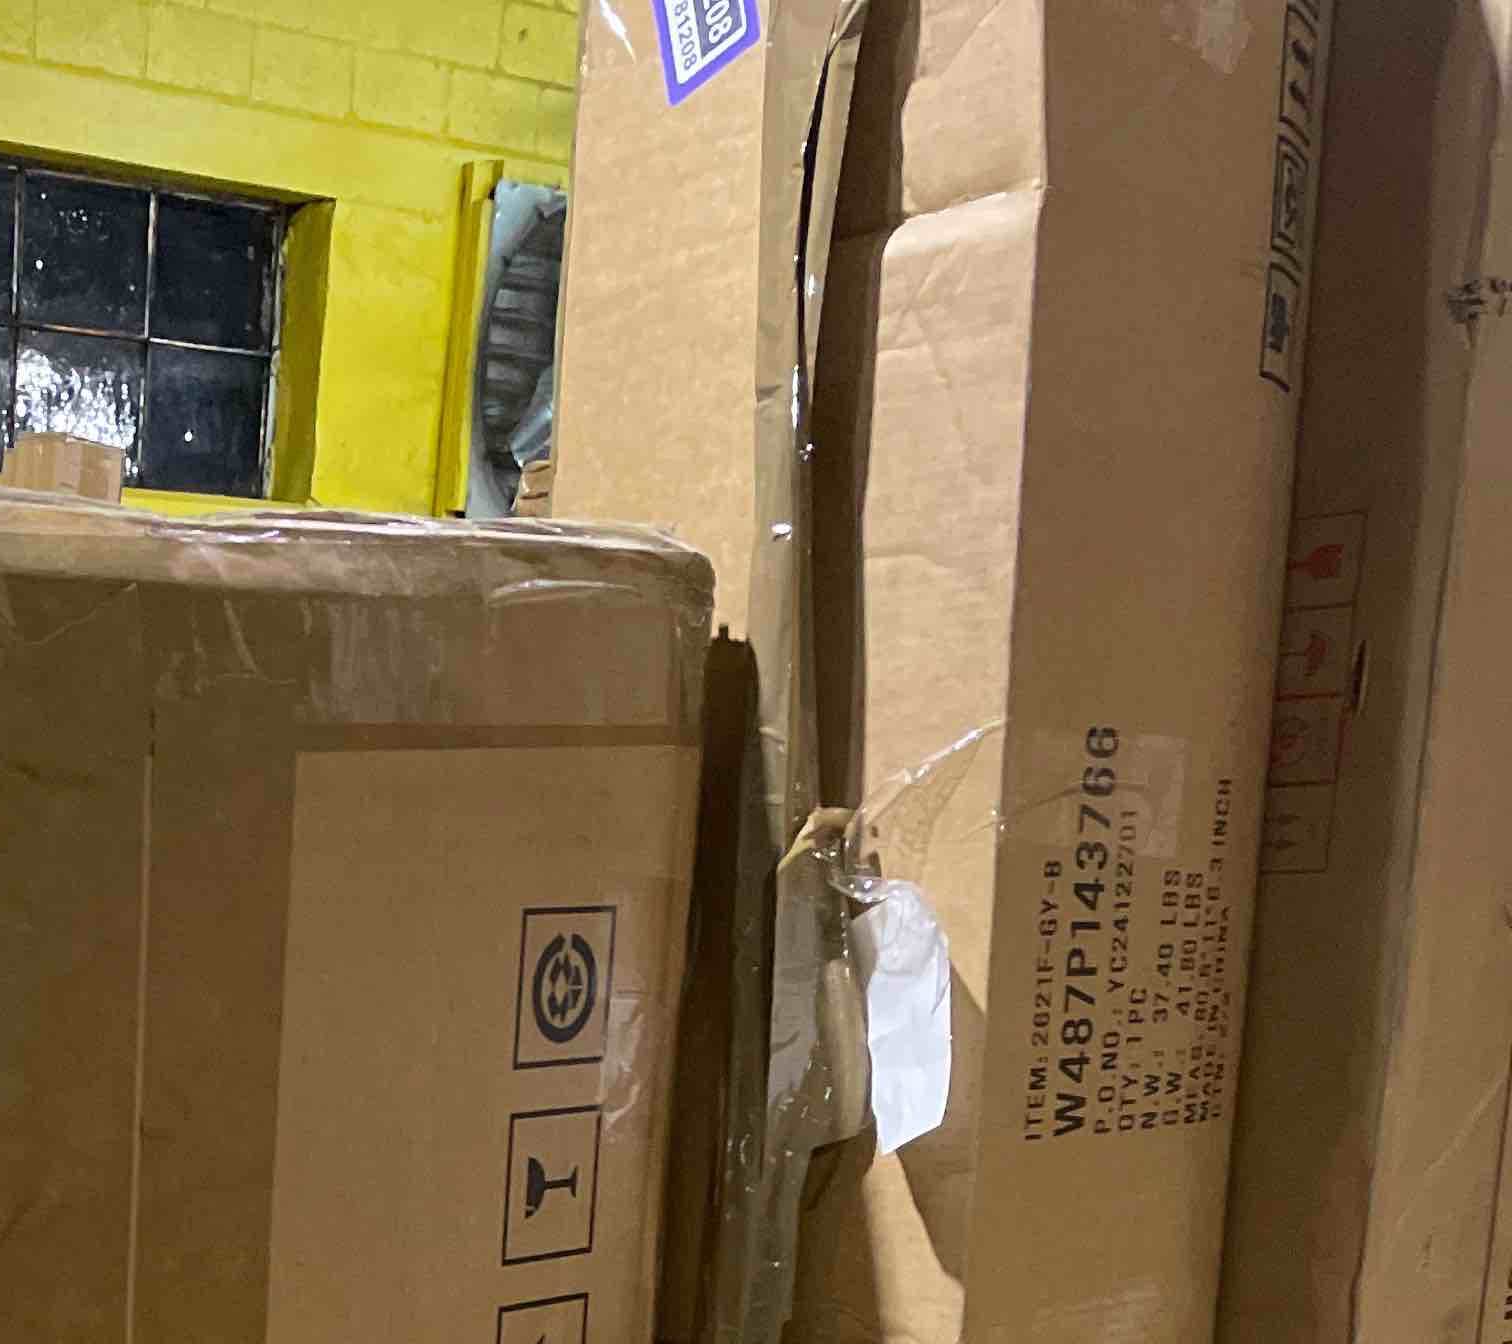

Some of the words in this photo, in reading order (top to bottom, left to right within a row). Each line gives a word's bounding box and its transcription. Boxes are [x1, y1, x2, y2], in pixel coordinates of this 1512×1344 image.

[1210, 777, 1233, 847] INCH
[1160, 869, 1183, 927] LBS
[1184, 871, 1205, 928] LBS
[1051, 725, 1121, 1138] W487P143766
